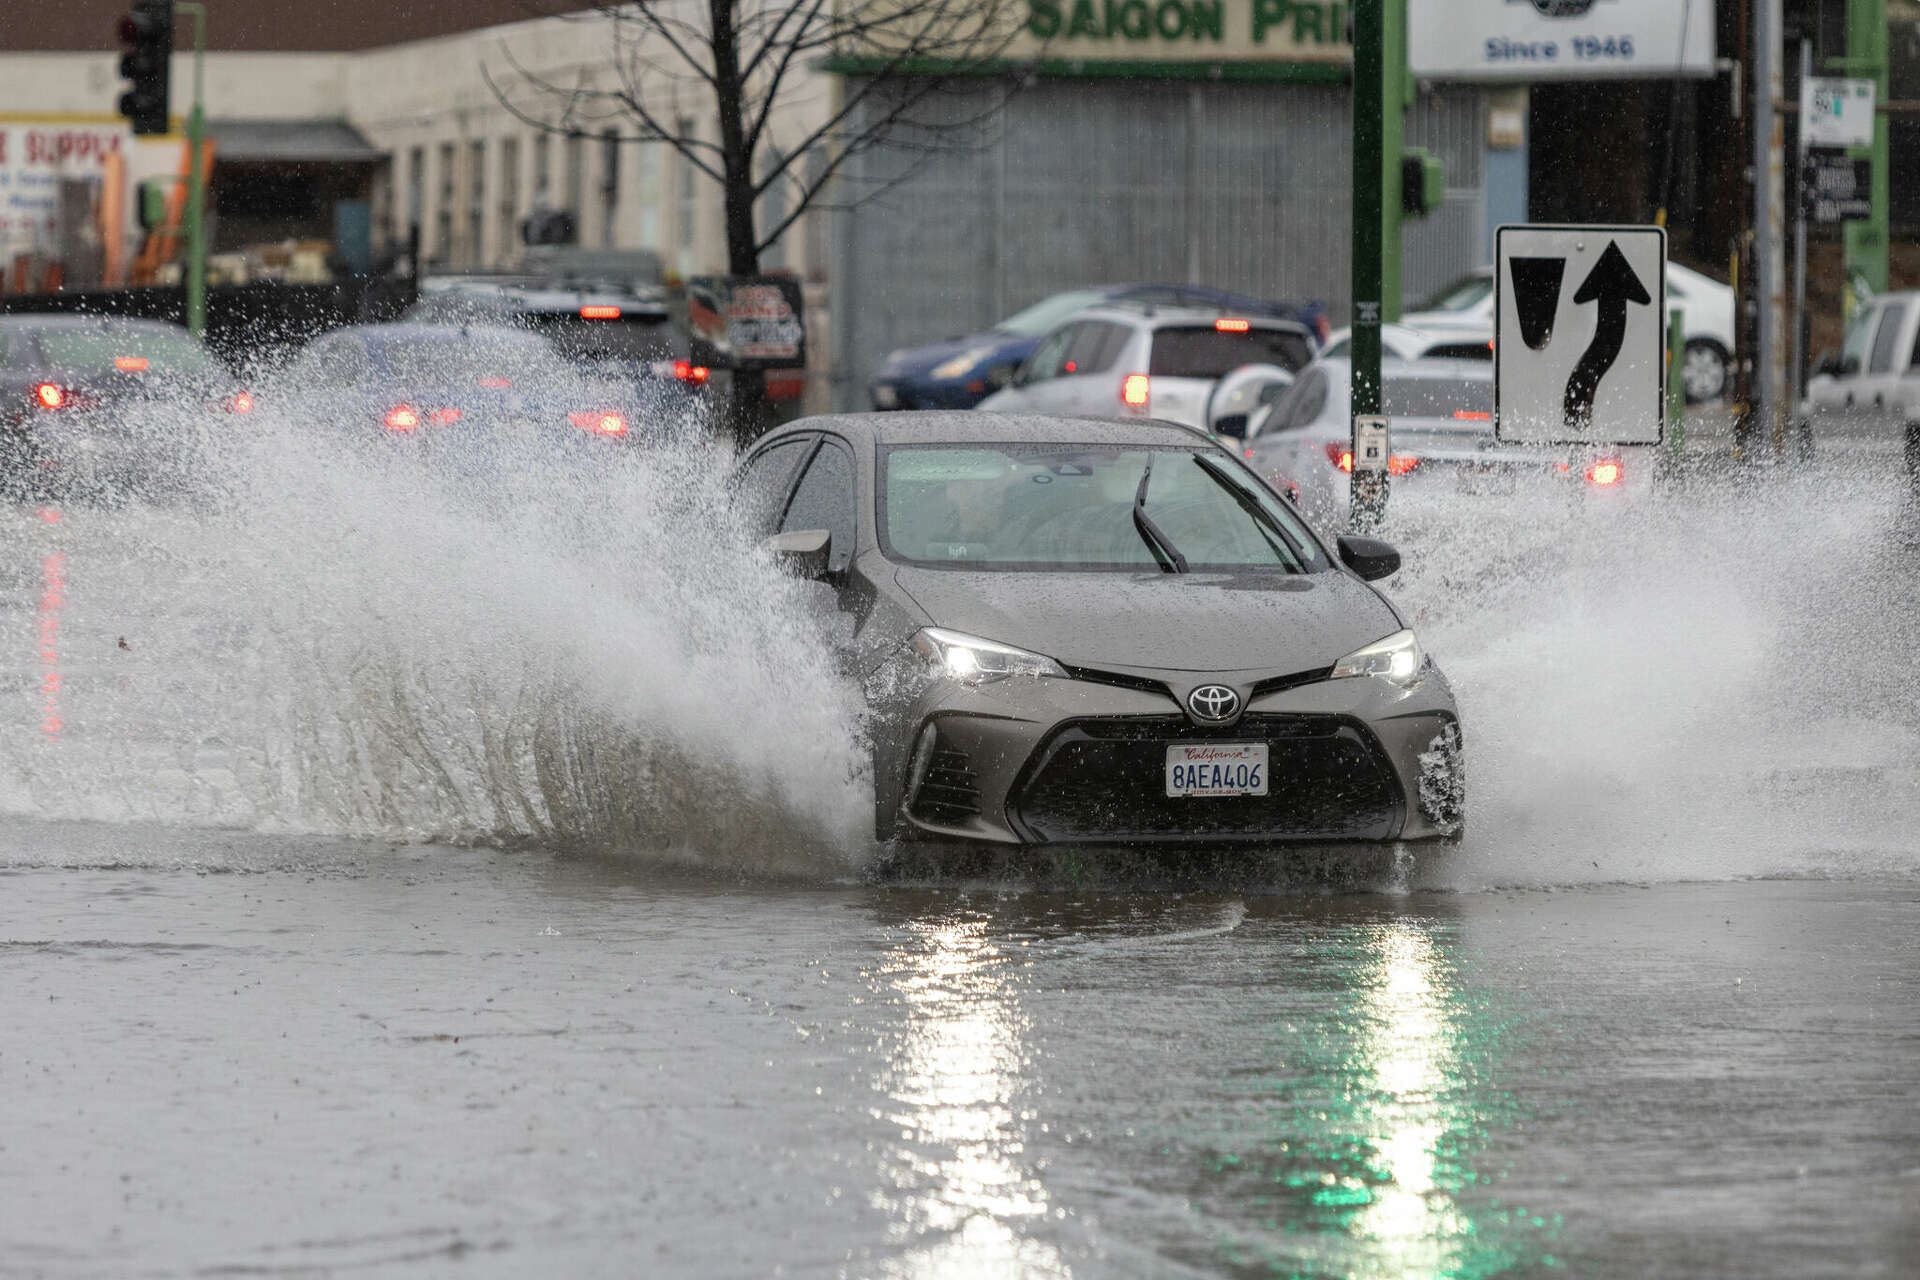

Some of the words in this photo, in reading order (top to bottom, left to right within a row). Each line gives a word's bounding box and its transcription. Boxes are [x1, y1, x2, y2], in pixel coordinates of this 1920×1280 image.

[1029, 0, 1223, 41] SAIGON
[1485, 37, 1558, 61] Since
[1571, 35, 1635, 60] 1946
[1186, 747, 1248, 763] California
[1173, 763, 1262, 789] 8AEA406
